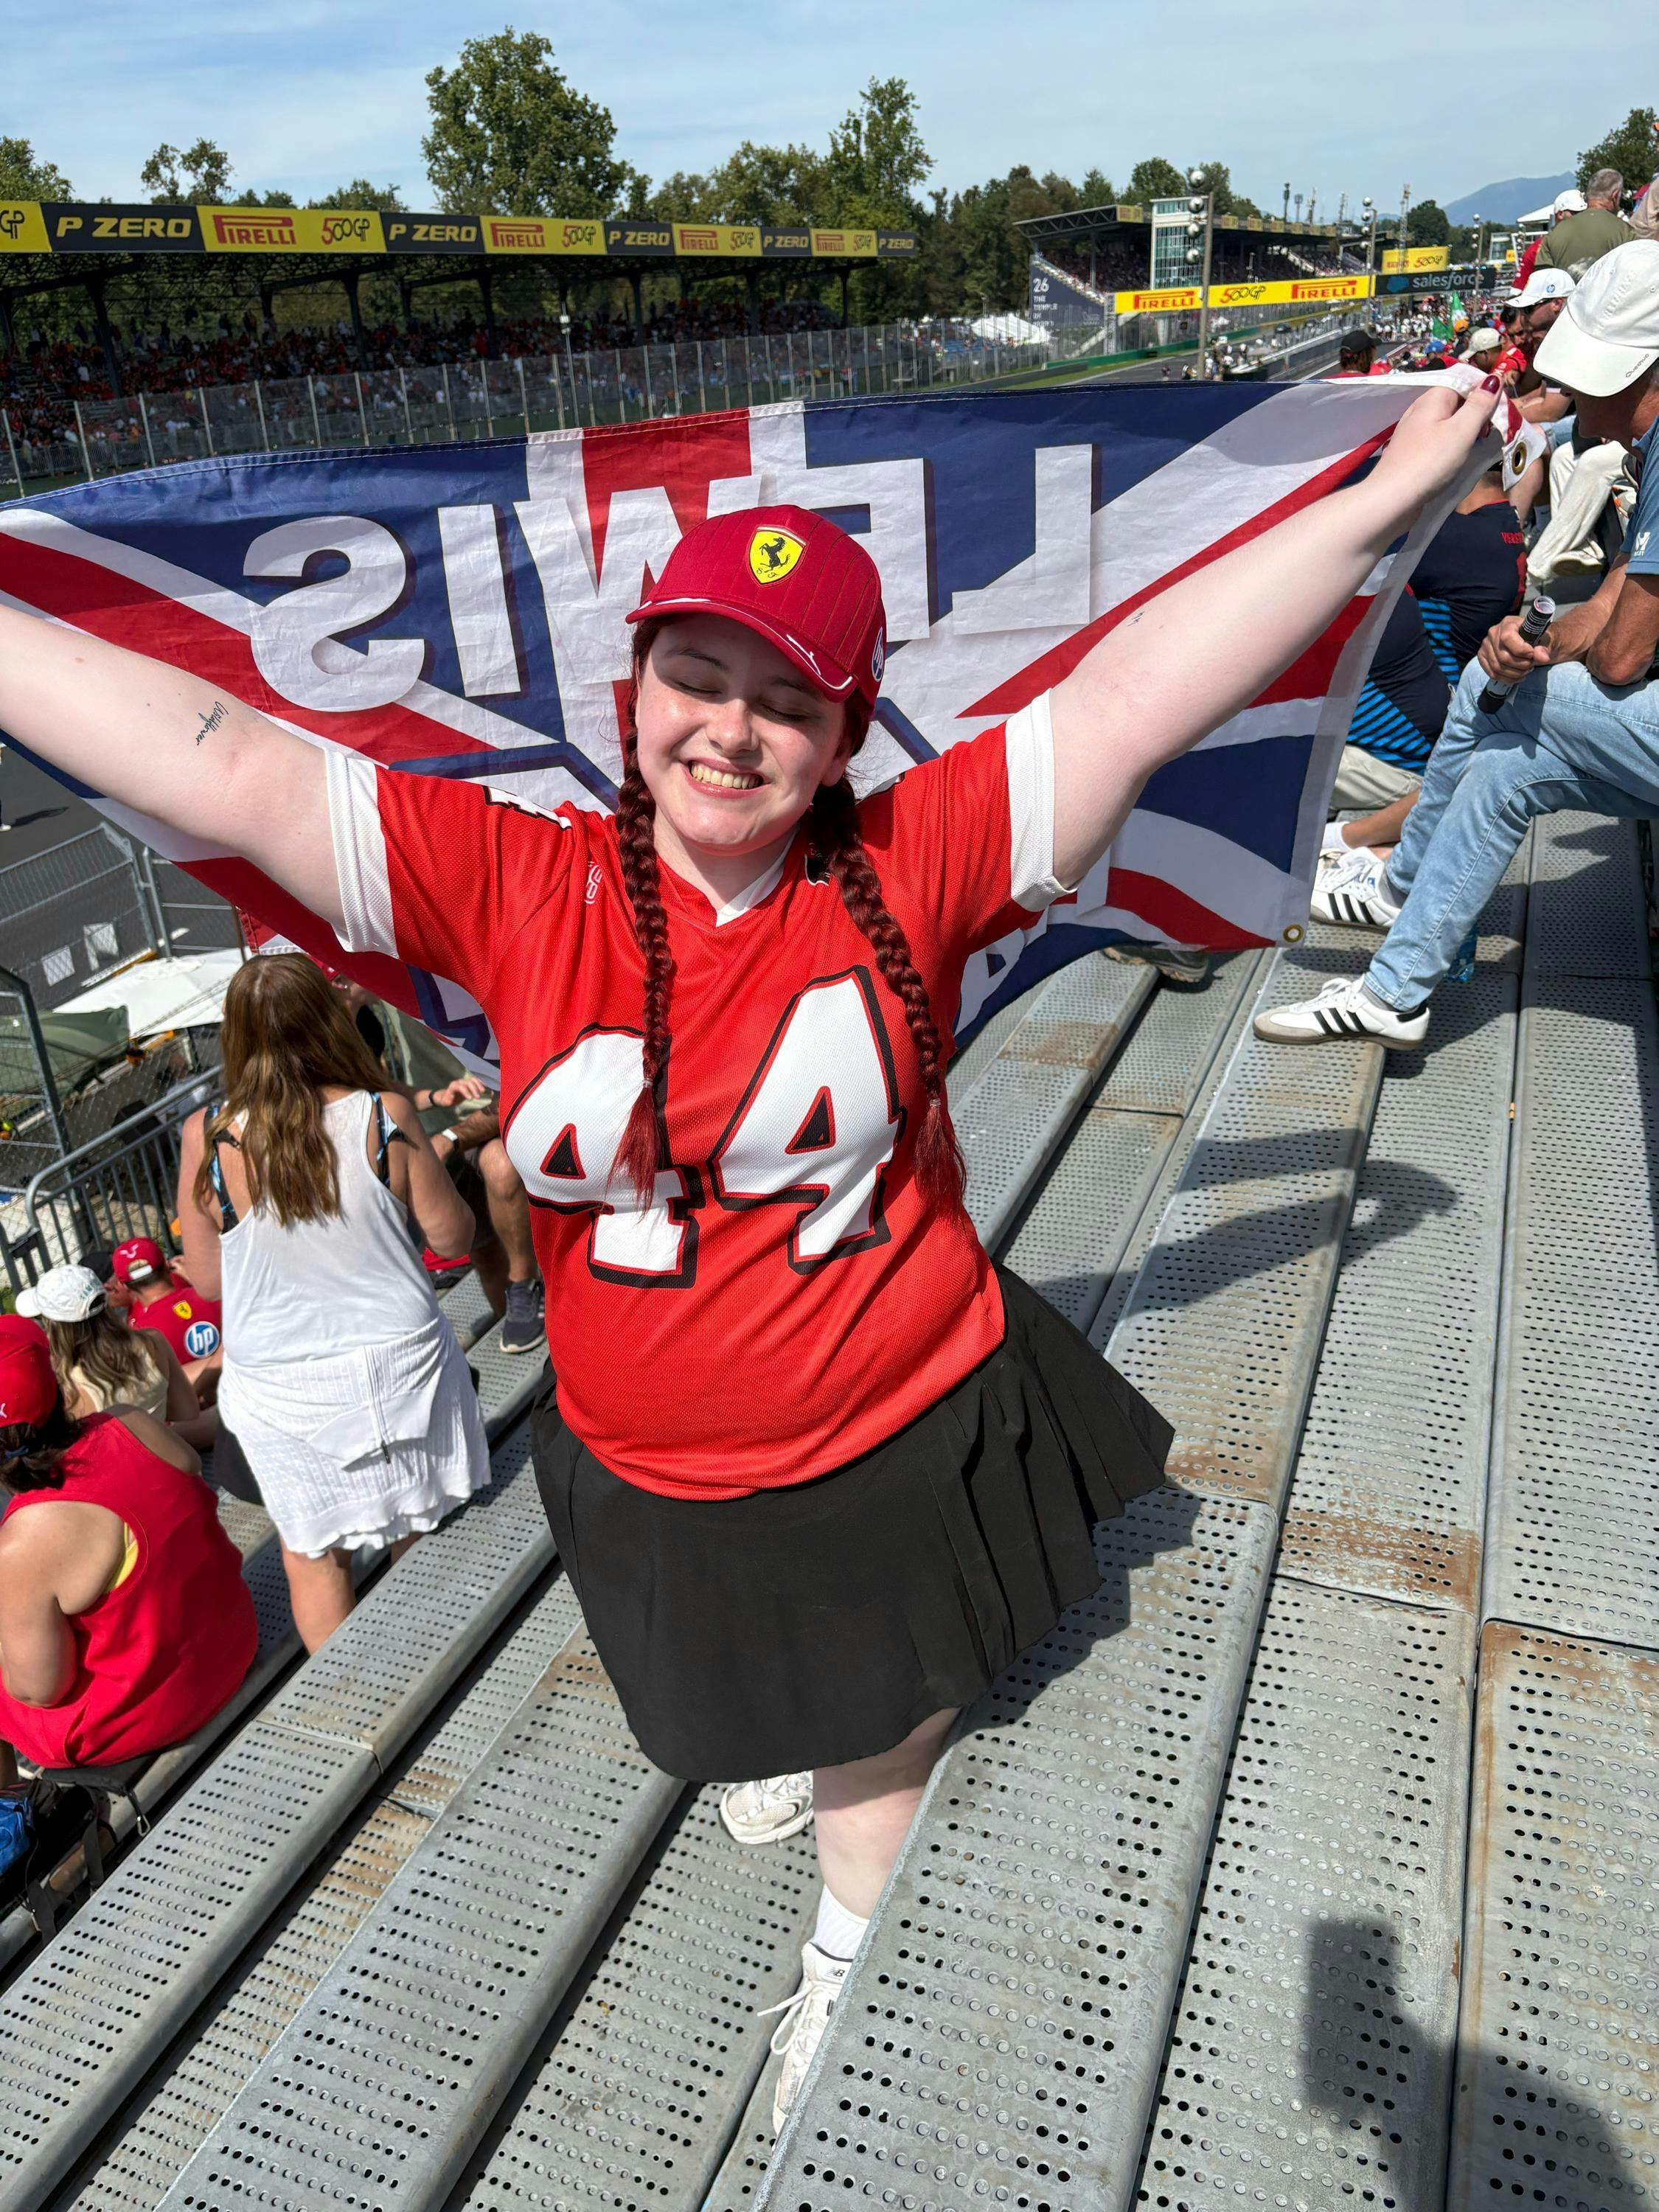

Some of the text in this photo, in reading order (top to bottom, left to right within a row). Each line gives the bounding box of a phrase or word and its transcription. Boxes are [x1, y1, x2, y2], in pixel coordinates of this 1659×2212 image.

[56, 217, 192, 237] P ZERO
[212, 215, 296, 245] PIRELLI
[389, 223, 477, 242] P ZERO
[490, 223, 546, 248] PIRELLI
[608, 231, 670, 246] P ZERO
[680, 229, 718, 250] PIRELLI
[763, 235, 809, 248] P ZERO
[887, 239, 914, 248] ZERO
[1033, 278, 1049, 292] 26
[1291, 280, 1357, 299] PIRELLI
[1413, 271, 1484, 289] salesforce
[1133, 291, 1194, 310] PIRELLI
[504, 964, 907, 1290] 44
[189, 1323, 215, 1357] hp
